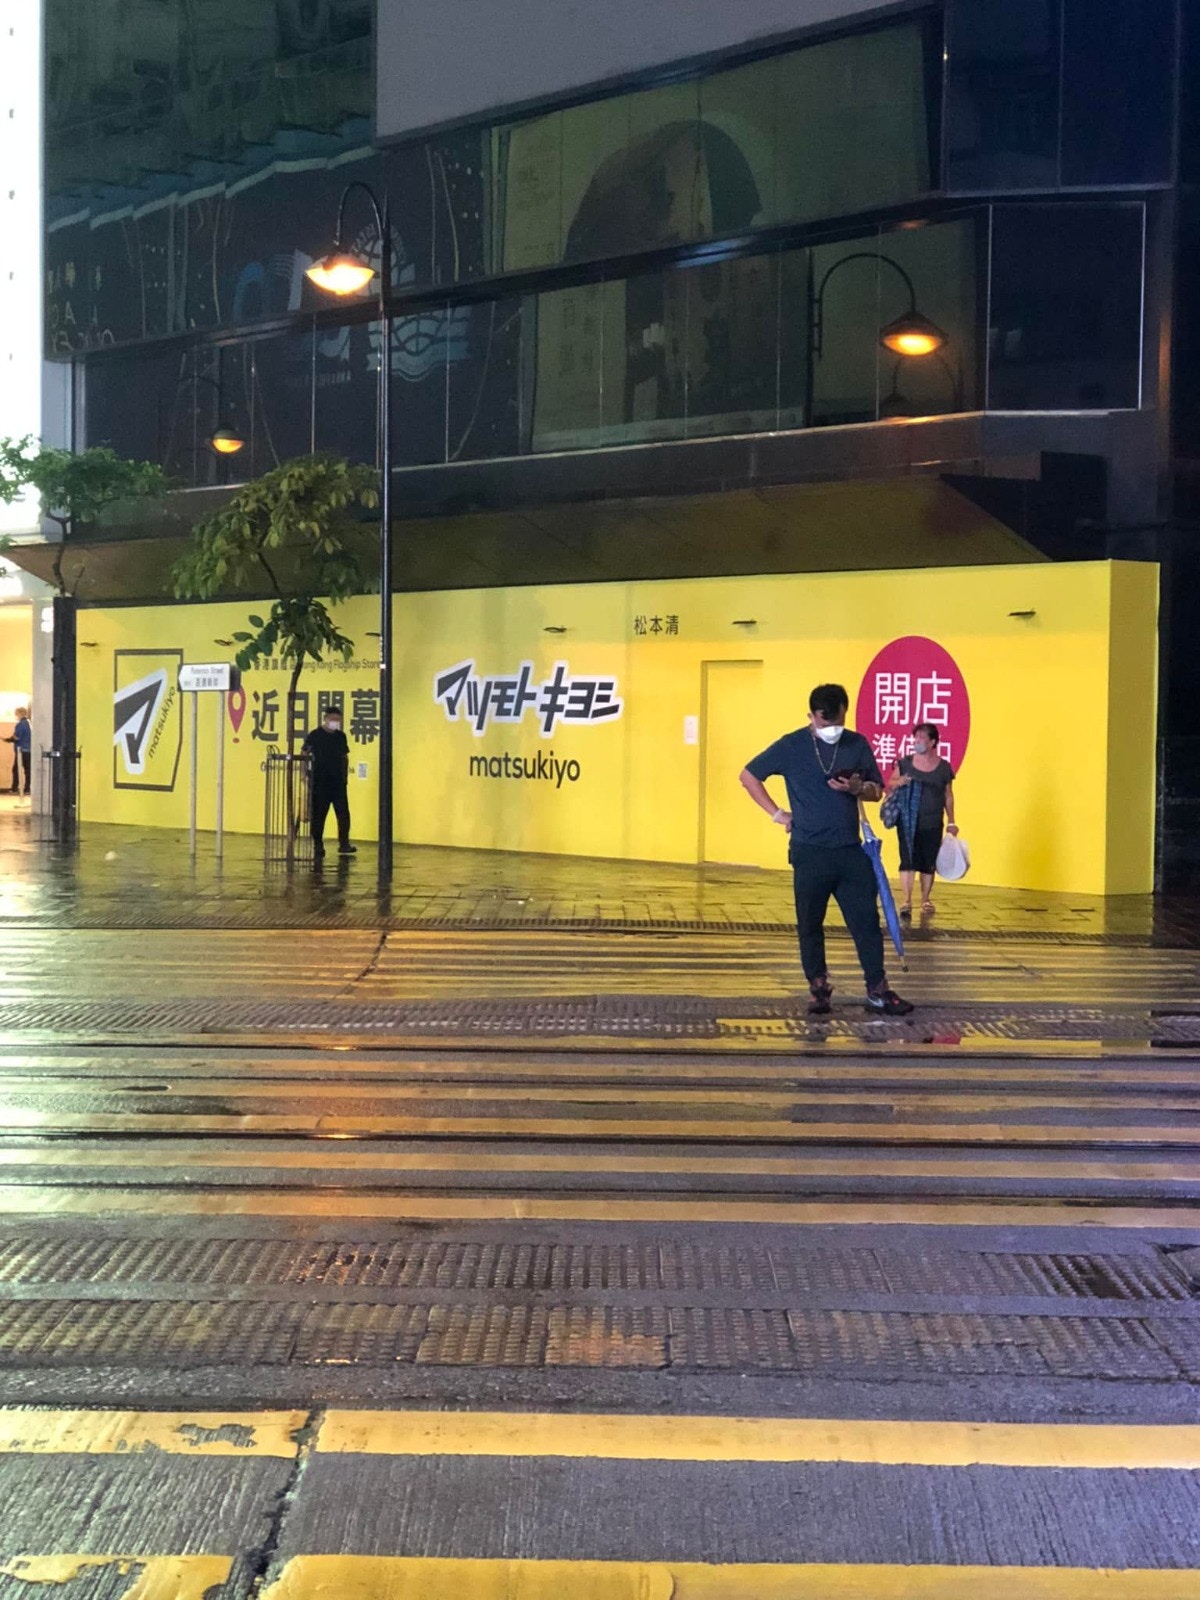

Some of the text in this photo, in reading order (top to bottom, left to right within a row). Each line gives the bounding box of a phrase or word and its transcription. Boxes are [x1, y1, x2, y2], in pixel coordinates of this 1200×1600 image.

[634, 615, 679, 636] 松本清
[149, 686, 176, 758] matsukiyo
[437, 664, 620, 732] マツモトキヨシ
[874, 671, 952, 726] 開店
[469, 750, 581, 789] matsukiyo
